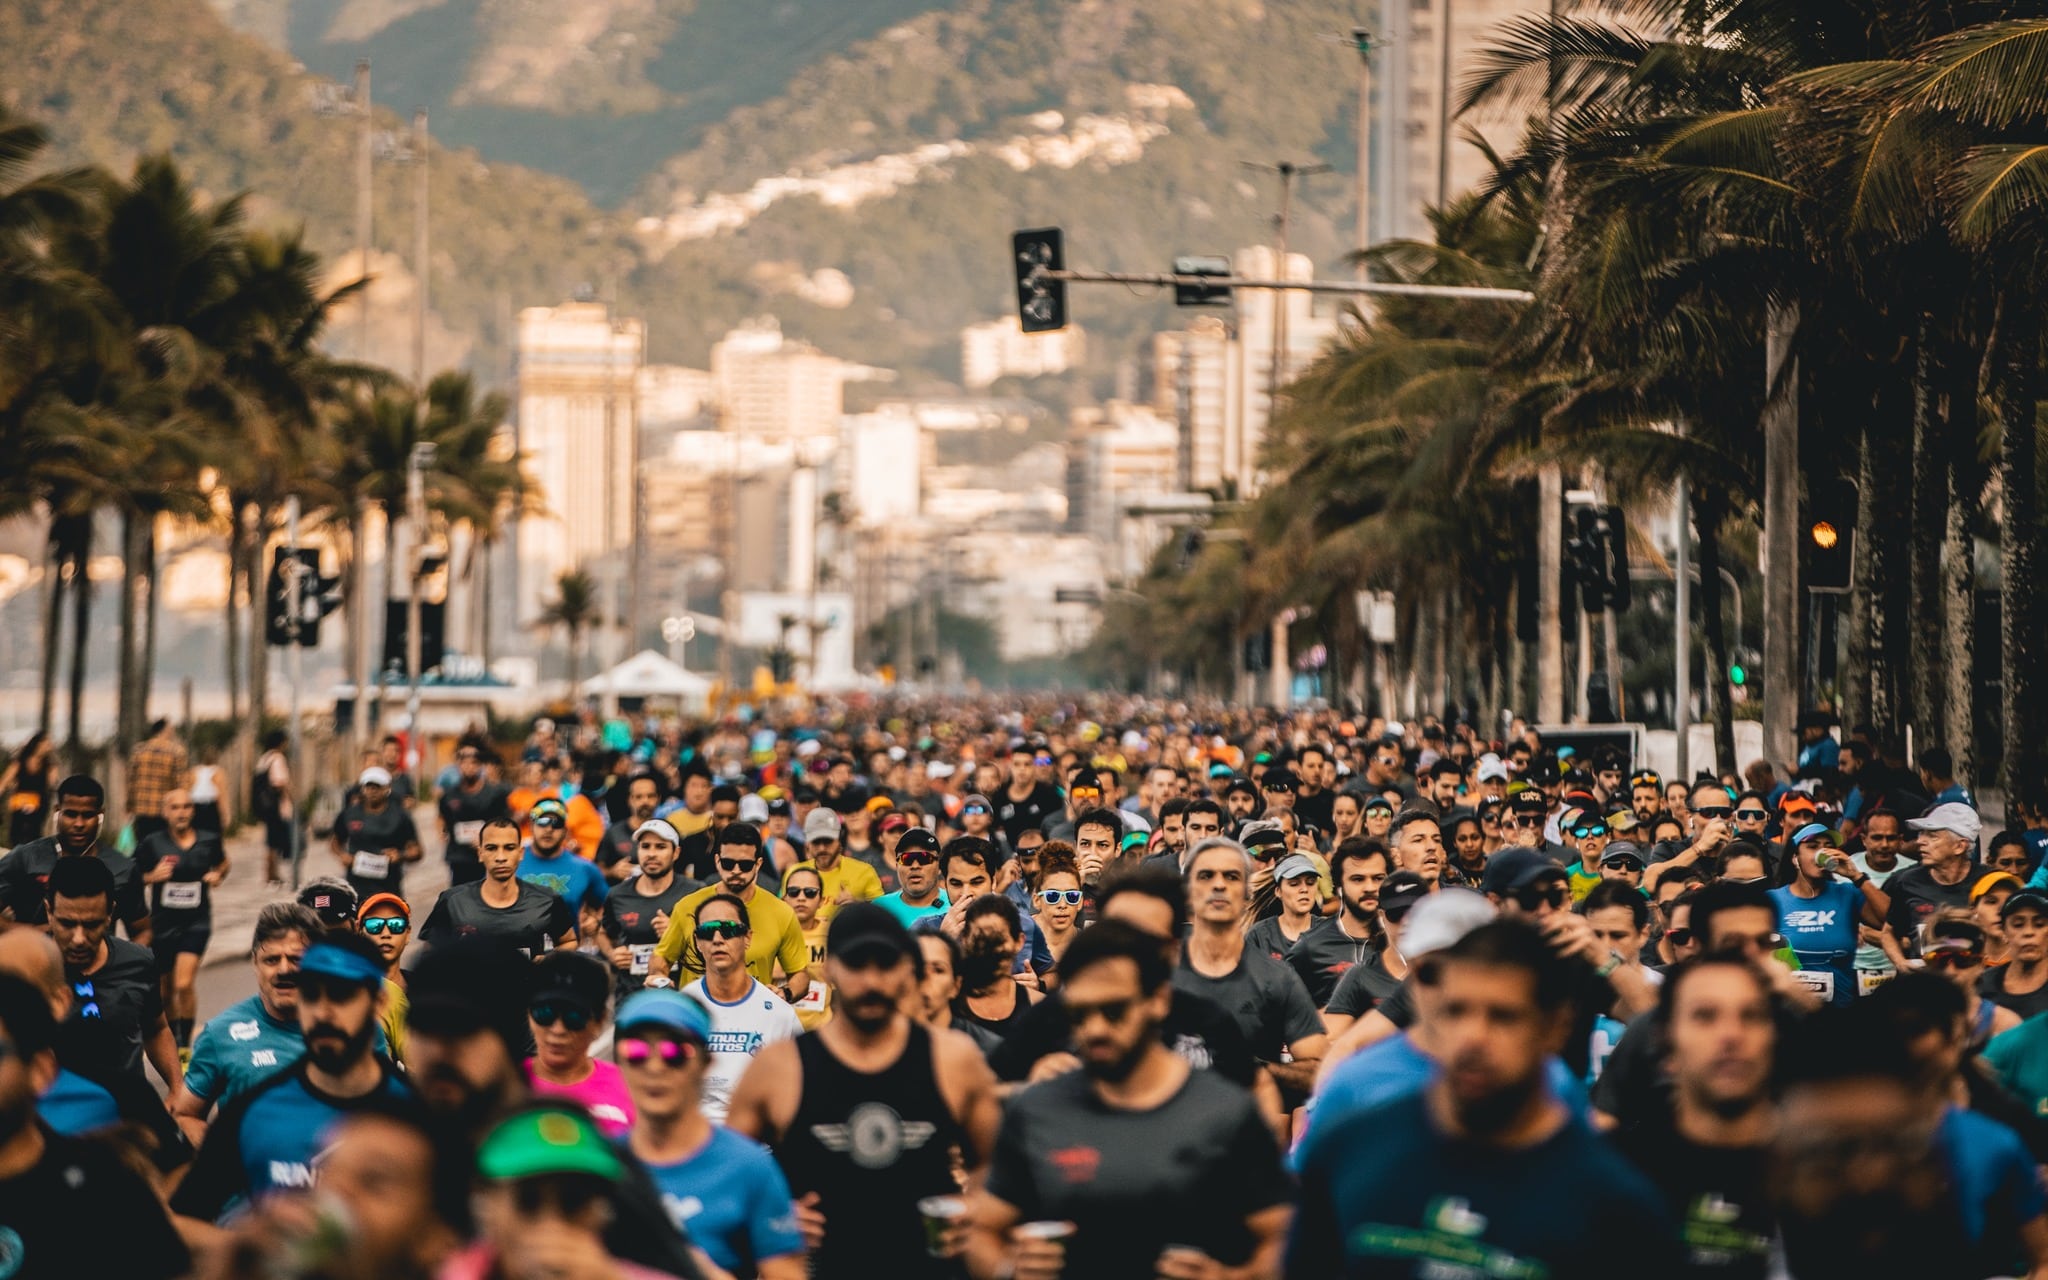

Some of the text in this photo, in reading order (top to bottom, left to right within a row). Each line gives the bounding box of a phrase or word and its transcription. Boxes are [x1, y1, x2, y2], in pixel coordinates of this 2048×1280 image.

[1791, 910, 1836, 926] ZK
[708, 1033, 748, 1043] MULO
[708, 1043, 745, 1052] NTOS
